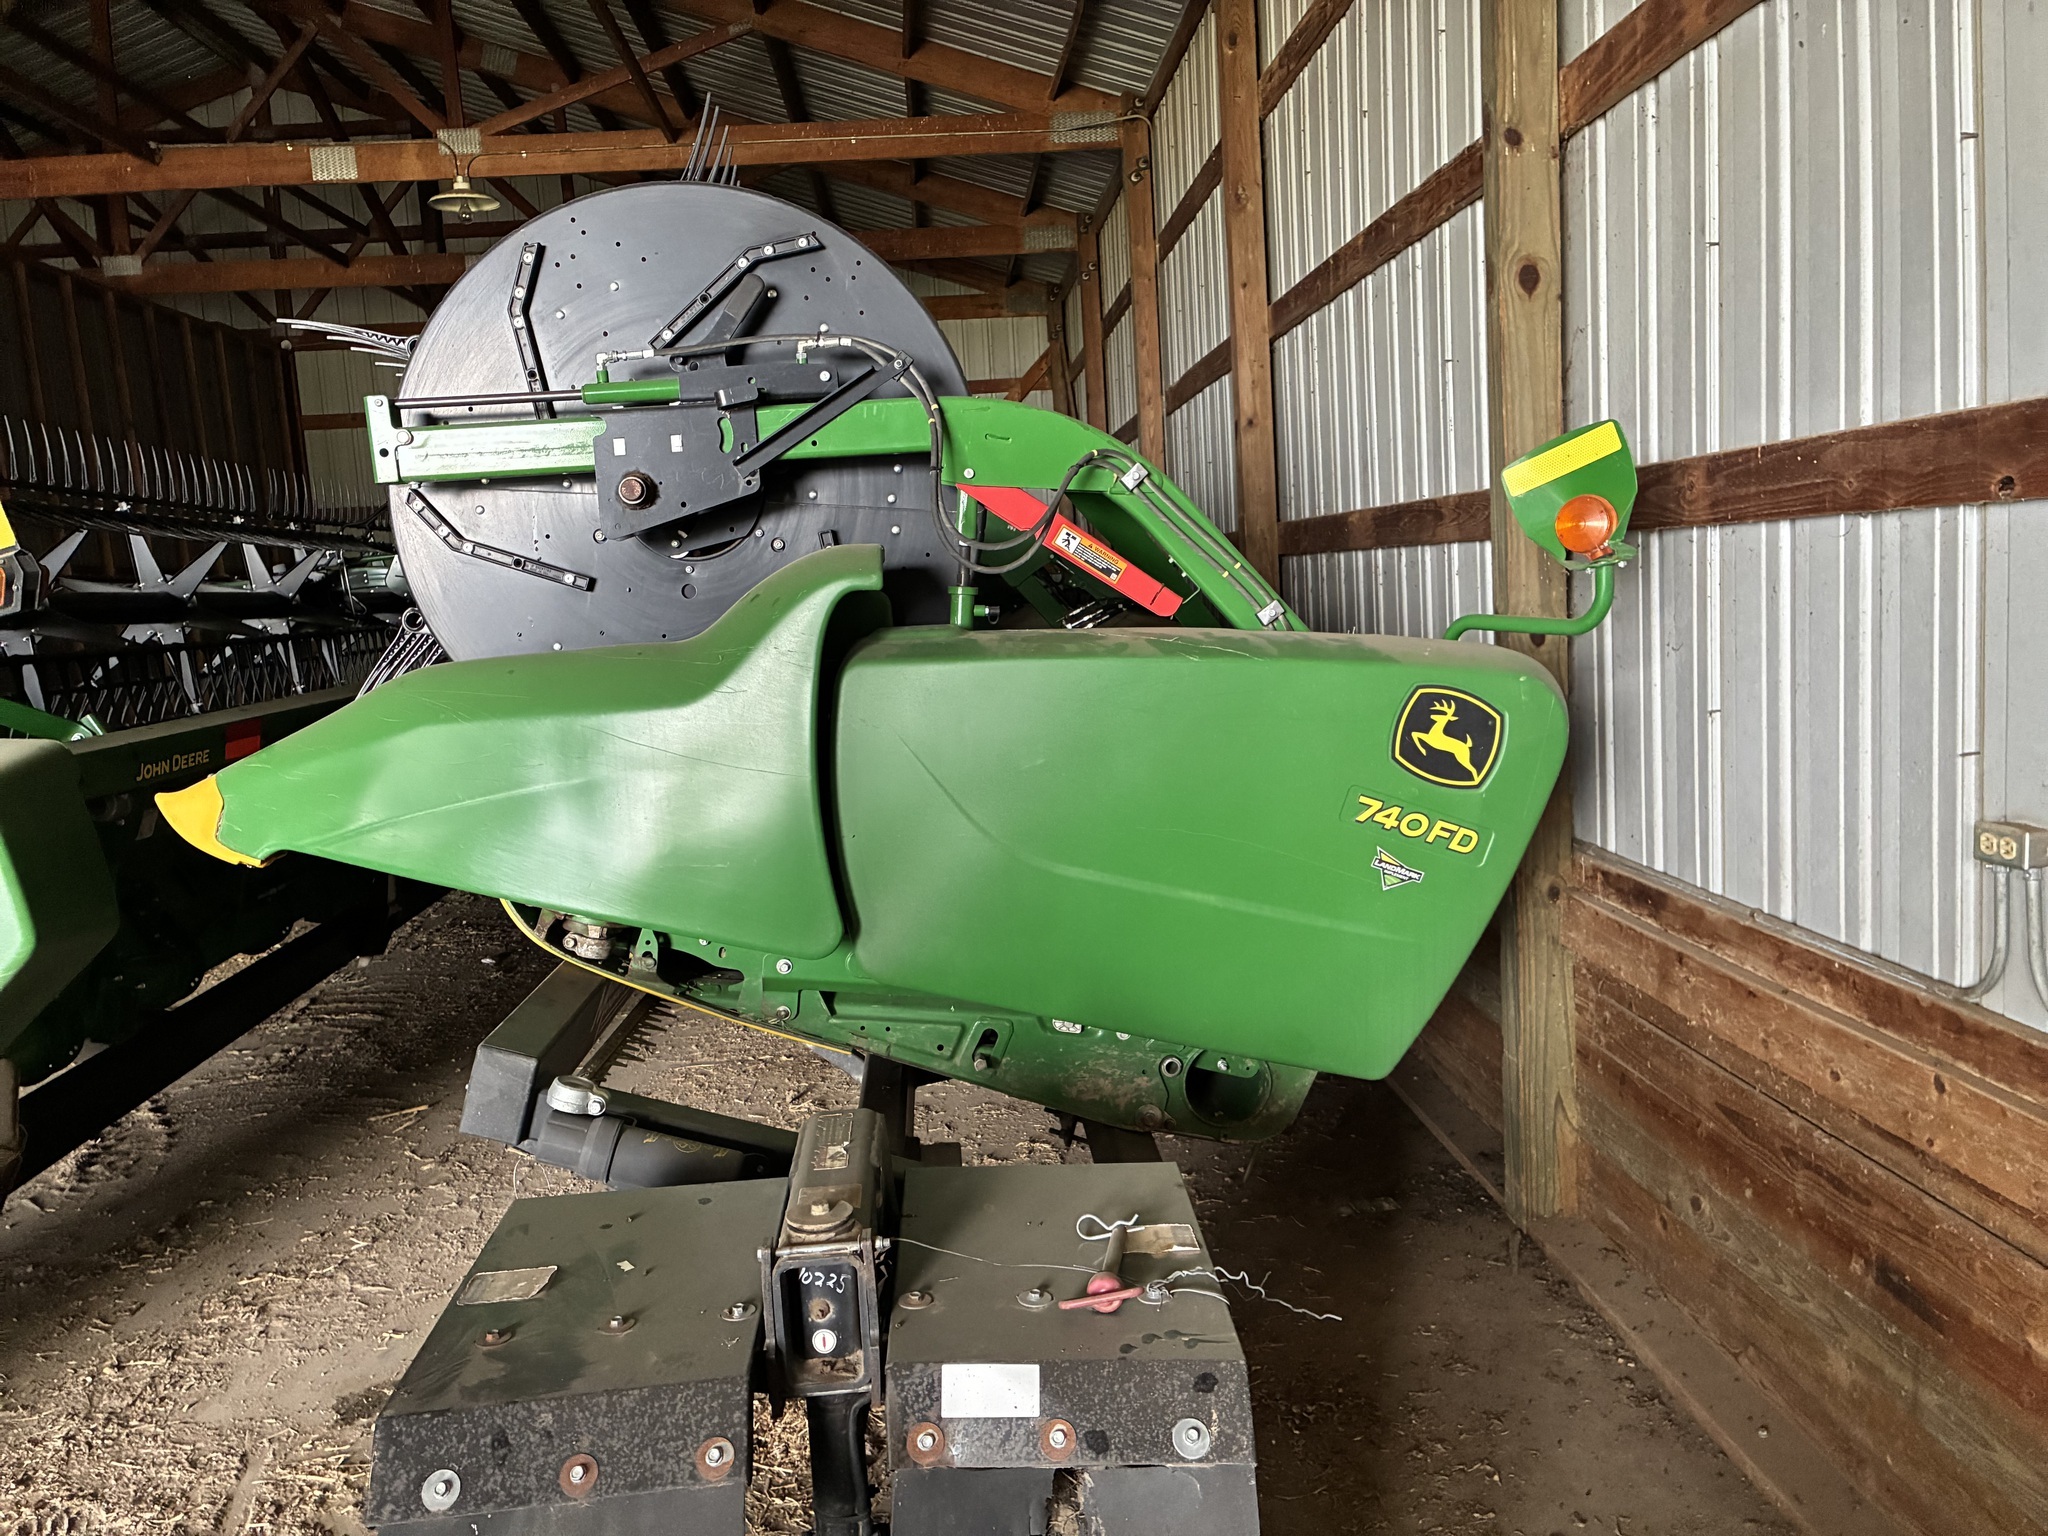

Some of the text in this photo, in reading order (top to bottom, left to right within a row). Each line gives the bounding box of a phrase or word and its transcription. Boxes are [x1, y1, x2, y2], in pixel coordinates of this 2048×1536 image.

[1094, 546, 1120, 565] WARNING
[136, 749, 210, 782] JOHN DEERE
[1355, 793, 1480, 855] 740FD
[798, 1267, 852, 1294] 10225
